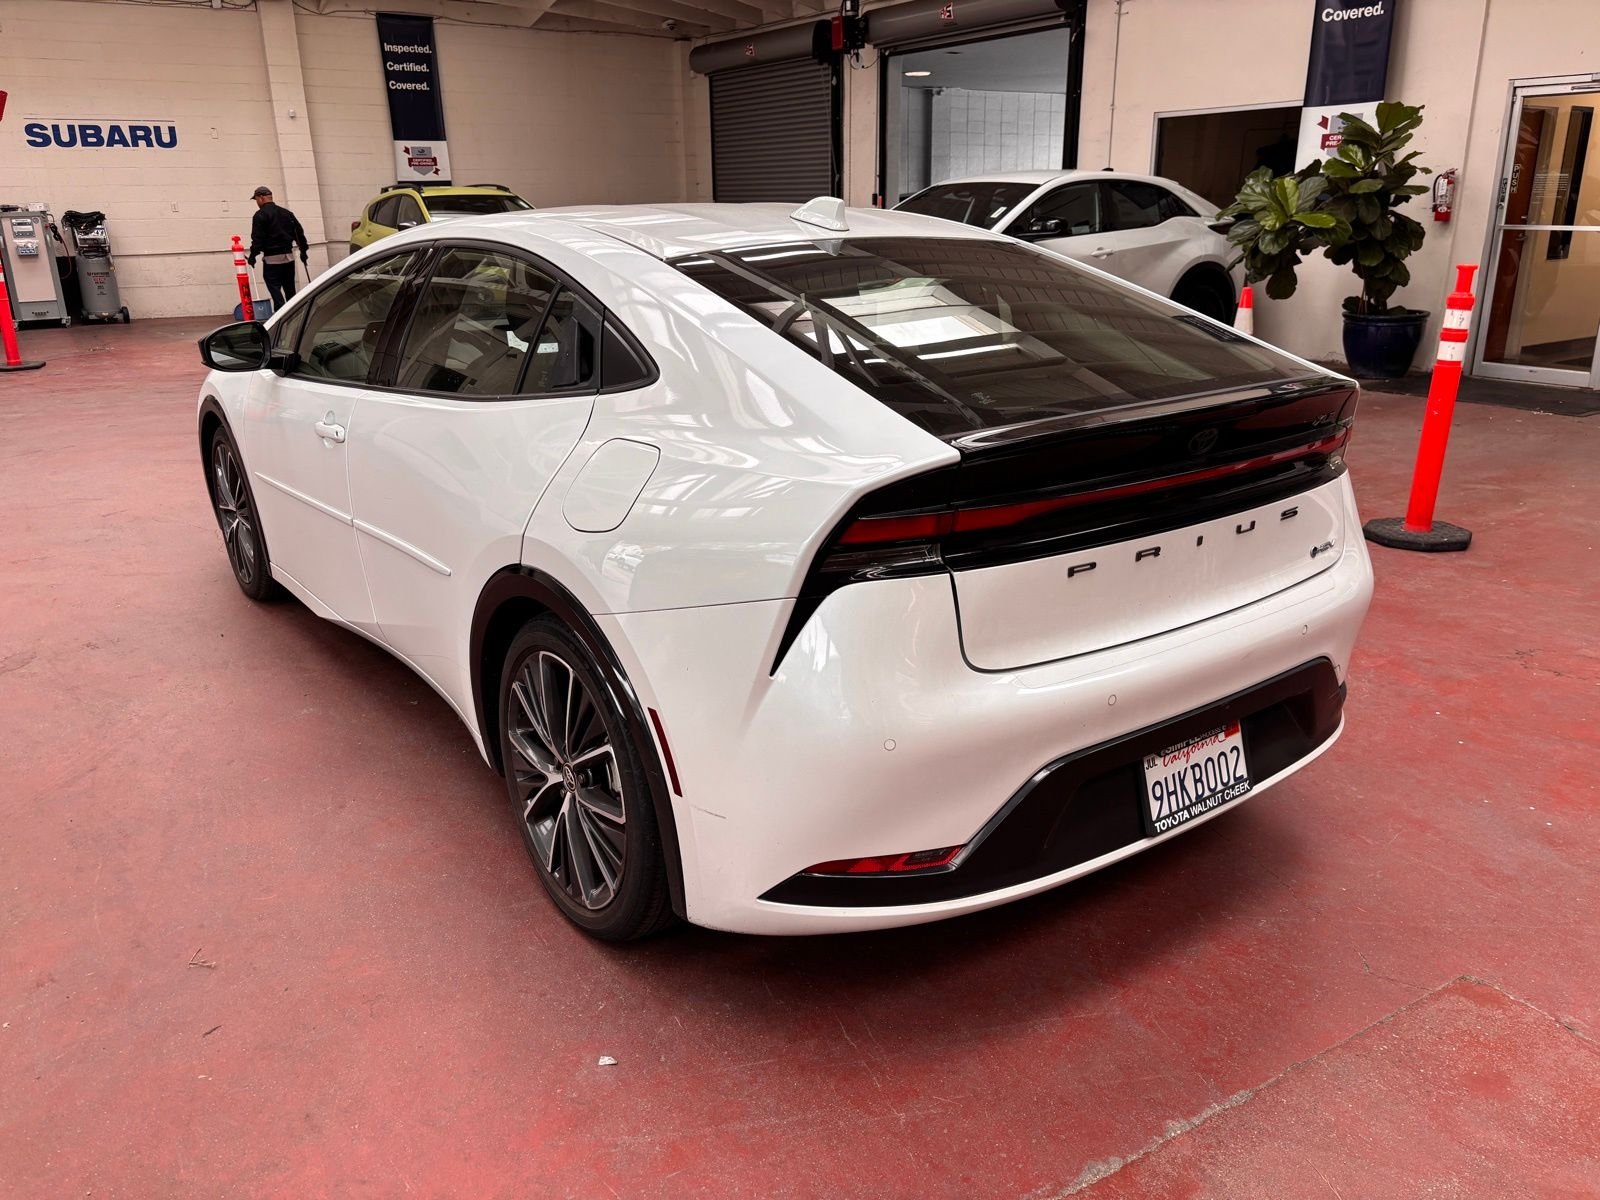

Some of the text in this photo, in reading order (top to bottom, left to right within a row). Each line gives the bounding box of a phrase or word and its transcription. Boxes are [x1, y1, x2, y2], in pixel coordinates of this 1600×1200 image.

[1321, 1, 1385, 23] Covered.
[384, 42, 433, 54] Inspected.
[386, 61, 430, 72] Certified.
[389, 80, 430, 91] Covered.
[24, 123, 178, 149] SUBARU
[1510, 165, 1520, 193] PUSH
[1067, 506, 1299, 578] PRIUS
[1145, 757, 1159, 771] JUL
[1162, 735, 1227, 768] California
[1151, 745, 1245, 821] 9HKB002
[1154, 811, 1190, 833] TOYOTA
[1190, 793, 1223, 817] WALNUT
